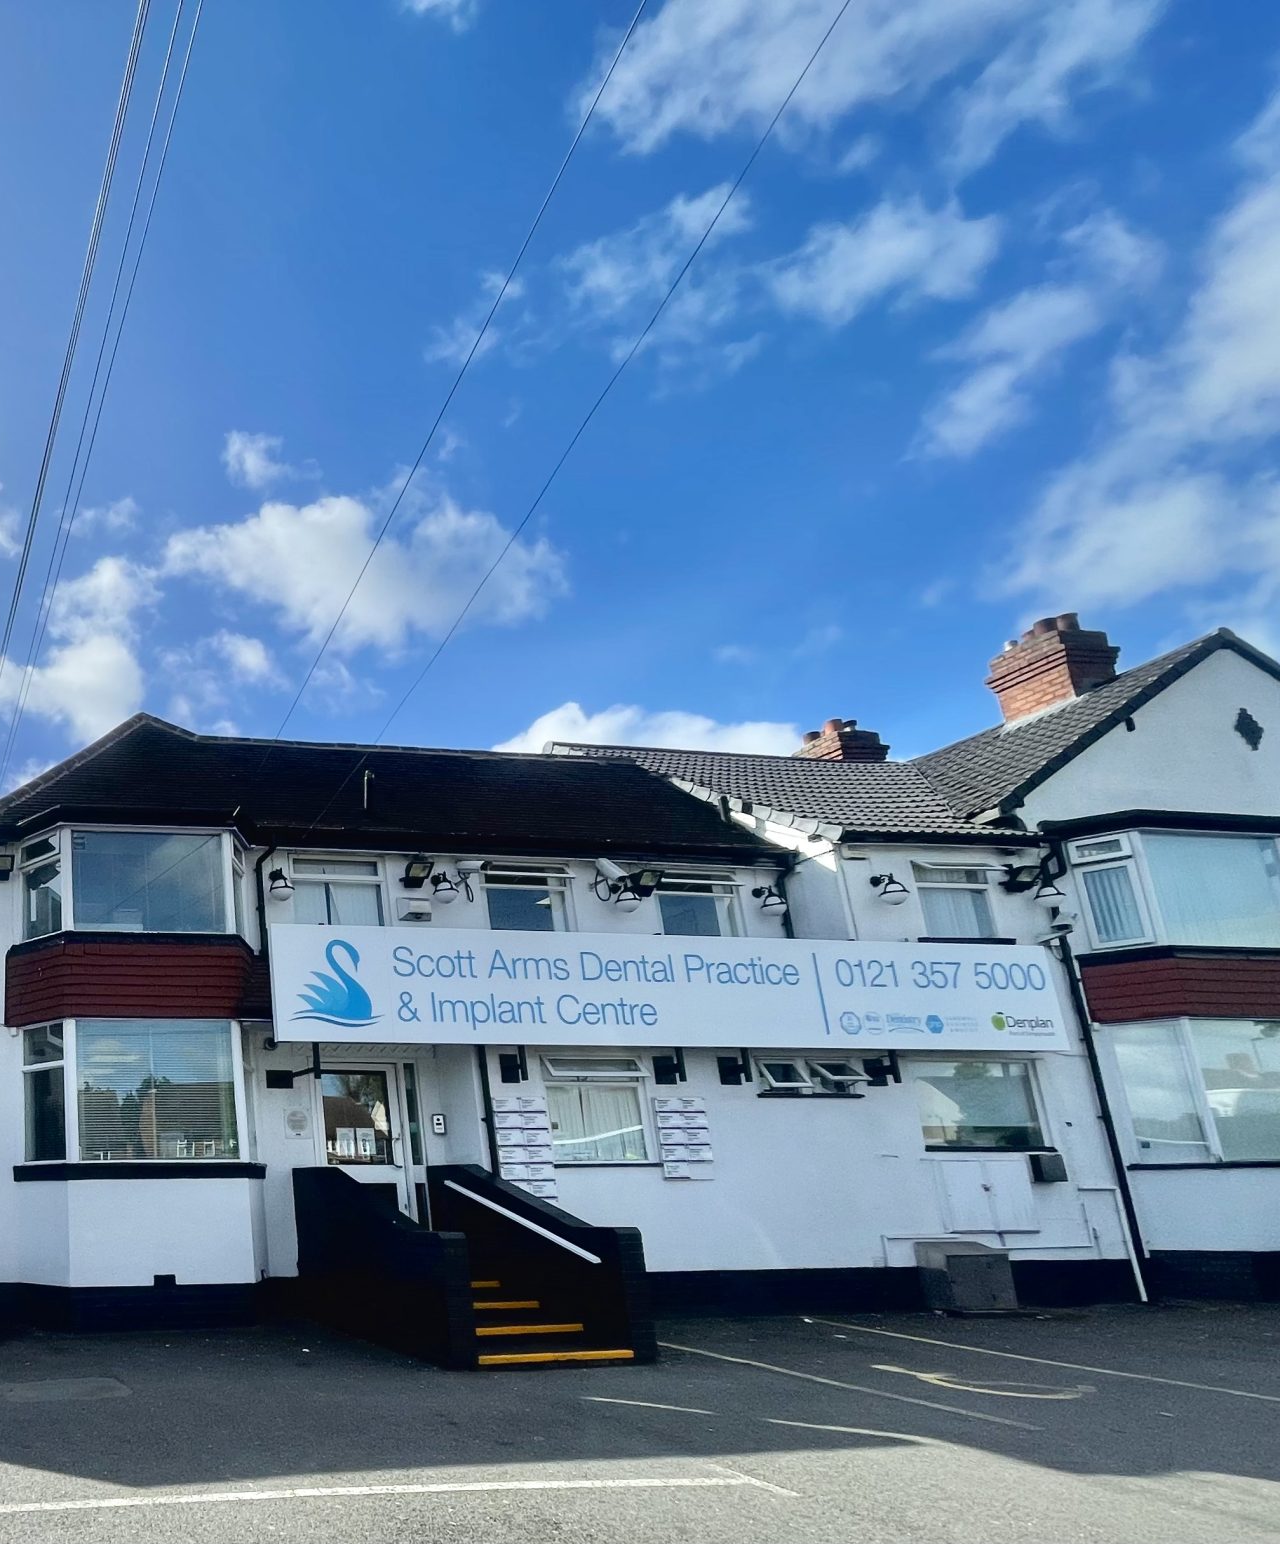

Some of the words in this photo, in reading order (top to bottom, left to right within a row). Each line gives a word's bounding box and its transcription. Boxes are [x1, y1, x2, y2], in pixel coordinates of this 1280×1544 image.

[392, 946, 478, 979] Scott
[488, 949, 571, 981] Arms
[580, 951, 676, 984] Dental
[684, 954, 800, 985] Practice
[835, 958, 900, 988] 0121
[911, 960, 962, 989] 357
[974, 962, 1046, 991] 5000
[397, 991, 421, 1022] &
[431, 992, 548, 1030] Implant
[556, 994, 659, 1026] Centre
[1005, 1015, 1054, 1031] Denplan
